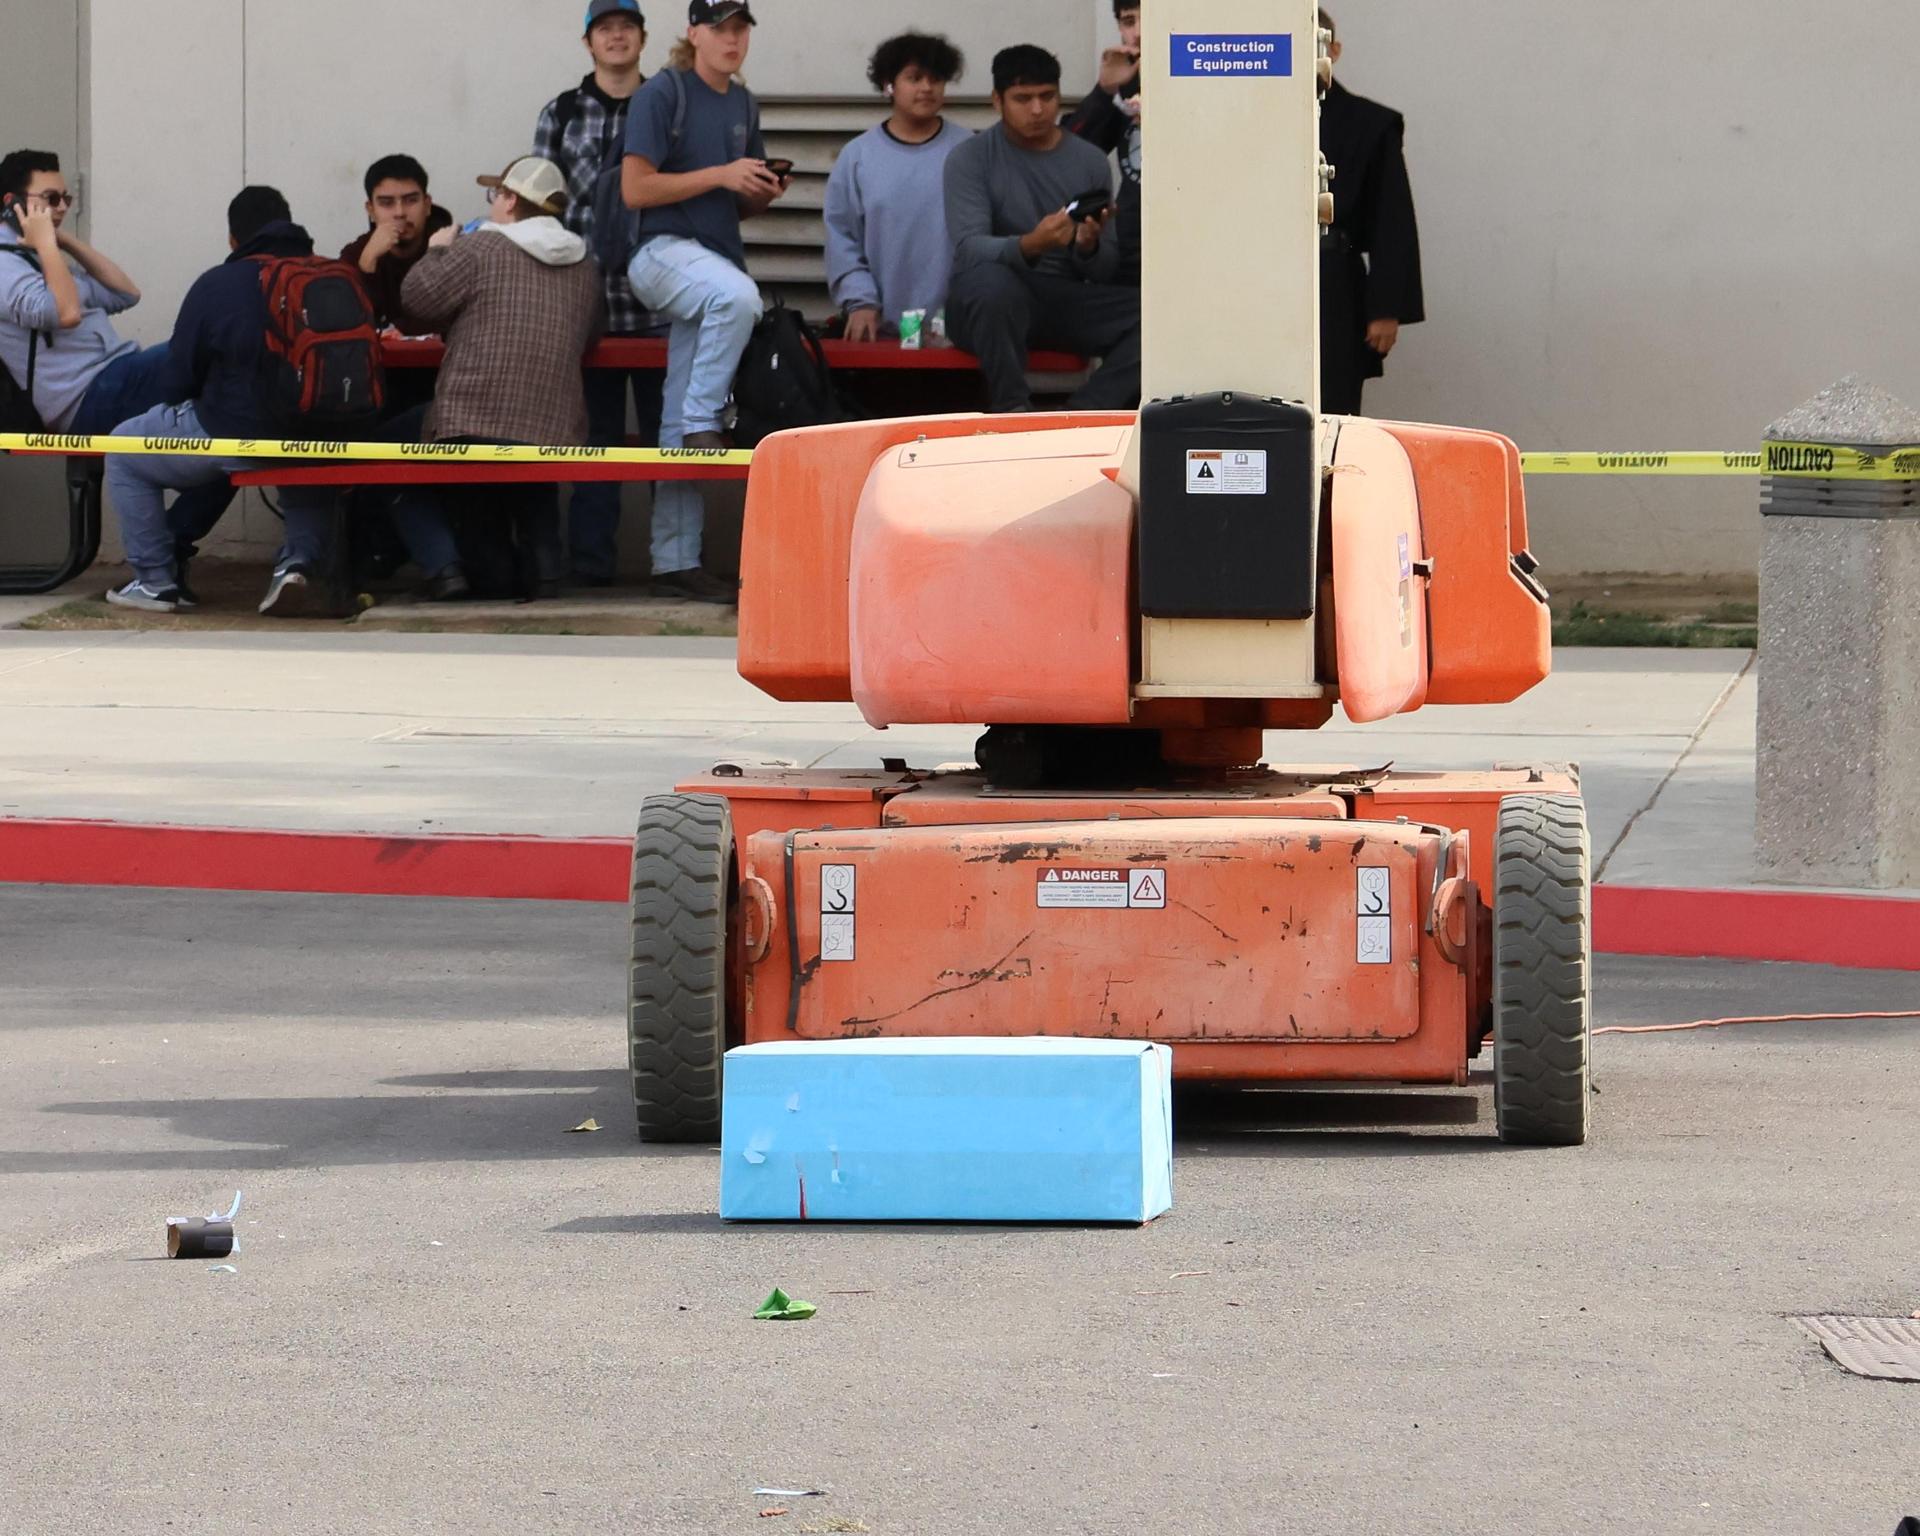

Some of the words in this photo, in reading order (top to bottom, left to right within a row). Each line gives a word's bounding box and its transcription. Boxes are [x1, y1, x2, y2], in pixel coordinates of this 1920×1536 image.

[1187, 41, 1274, 53] Construction
[1193, 59, 1269, 72] Equipment
[1768, 446, 1834, 472] CAUTION
[1062, 870, 1119, 881] DANGER
